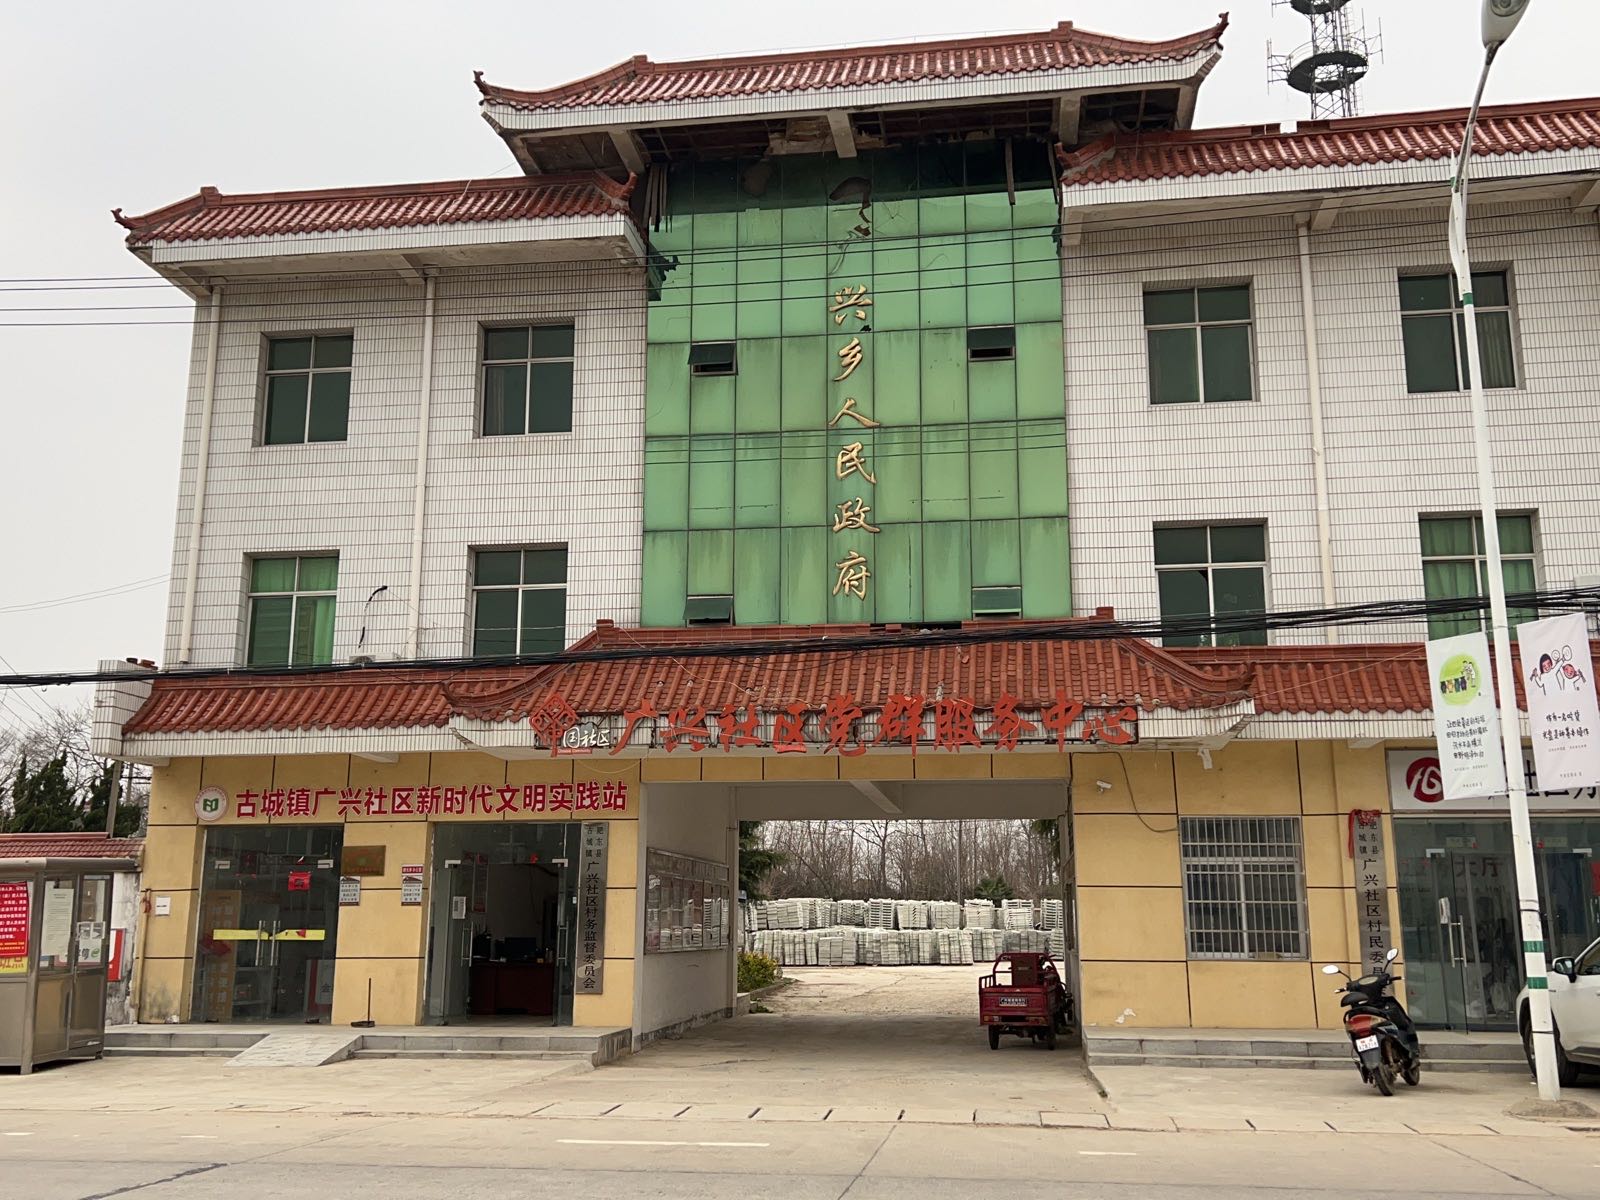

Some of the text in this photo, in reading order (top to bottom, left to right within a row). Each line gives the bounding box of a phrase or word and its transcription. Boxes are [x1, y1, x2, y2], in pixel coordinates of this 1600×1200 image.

[828, 283, 880, 601] 兴乡人民政府
[608, 688, 1138, 759] 广兴社区党群服务中心
[235, 780, 628, 818] 古城镇广兴社区新时代文明实践站
[583, 861, 600, 989] 广兴社区村务监督委员会
